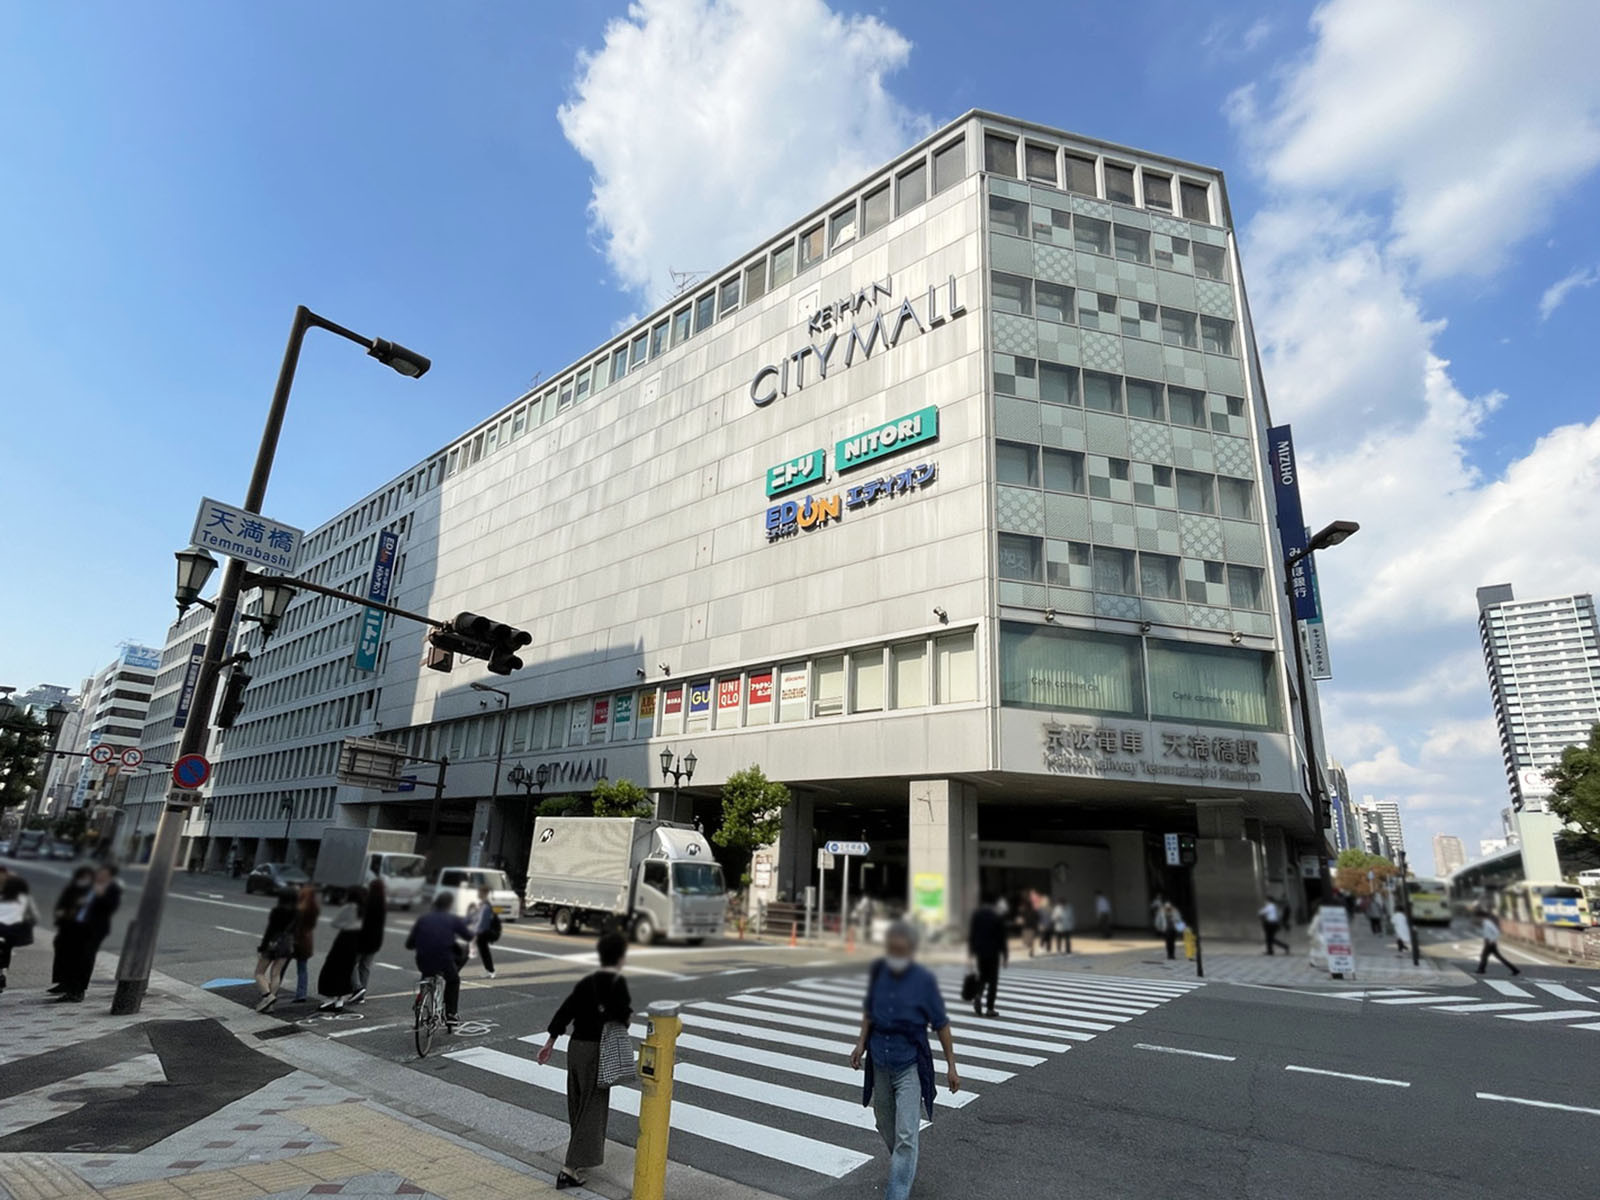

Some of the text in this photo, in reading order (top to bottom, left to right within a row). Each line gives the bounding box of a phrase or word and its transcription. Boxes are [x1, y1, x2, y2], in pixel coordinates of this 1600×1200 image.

[808, 273, 893, 337] KEIHAN
[844, 416, 921, 460] NITORI
[771, 455, 814, 488] ニトリ
[1277, 441, 1294, 486] MIZUHO
[846, 463, 936, 509] エディオン
[202, 530, 292, 568] Temmabashi
[206, 507, 295, 553] 天満橋
[361, 608, 380, 656] ニトリ
[692, 691, 711, 705] GU
[721, 681, 739, 693] UNI
[721, 693, 739, 706] QLO
[1161, 733, 1260, 765] 天満橋駅
